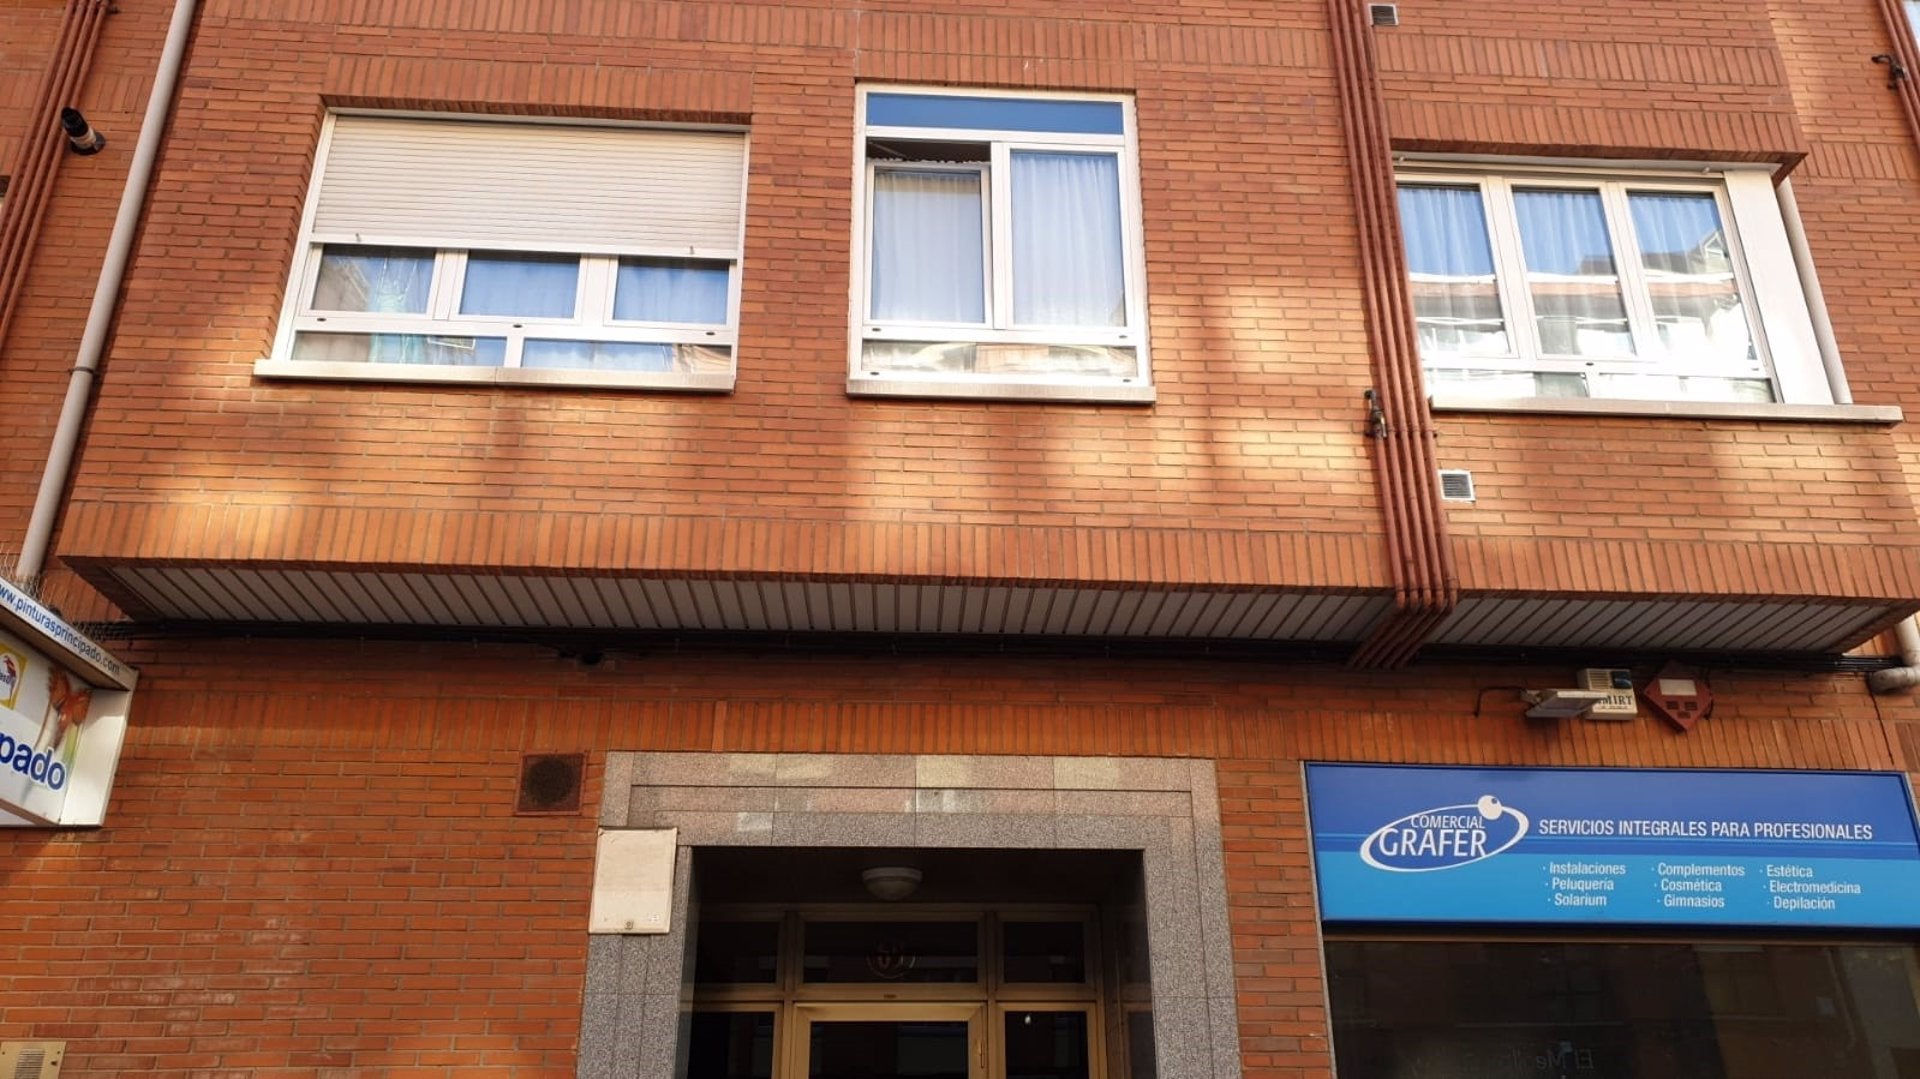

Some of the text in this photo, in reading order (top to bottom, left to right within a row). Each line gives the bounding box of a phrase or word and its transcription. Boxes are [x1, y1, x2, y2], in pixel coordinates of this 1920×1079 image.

[1411, 815, 1485, 829] COMERCIAL
[1539, 819, 1873, 840] SERVICIOS INTEGRALES PARA PROFESIONALES
[1379, 828, 1487, 857] GRAFER
[1549, 862, 1626, 875] Instalaciones
[1658, 862, 1745, 878] Complementos
[1767, 864, 1813, 878] Estética
[1552, 877, 1614, 892] Peluquería
[1661, 878, 1722, 892] Cosmética
[1769, 880, 1861, 894] Electromedicina
[1554, 892, 1607, 906] Solarium
[1664, 893, 1725, 908] Gimnasios
[1774, 896, 1836, 911] Depilación
